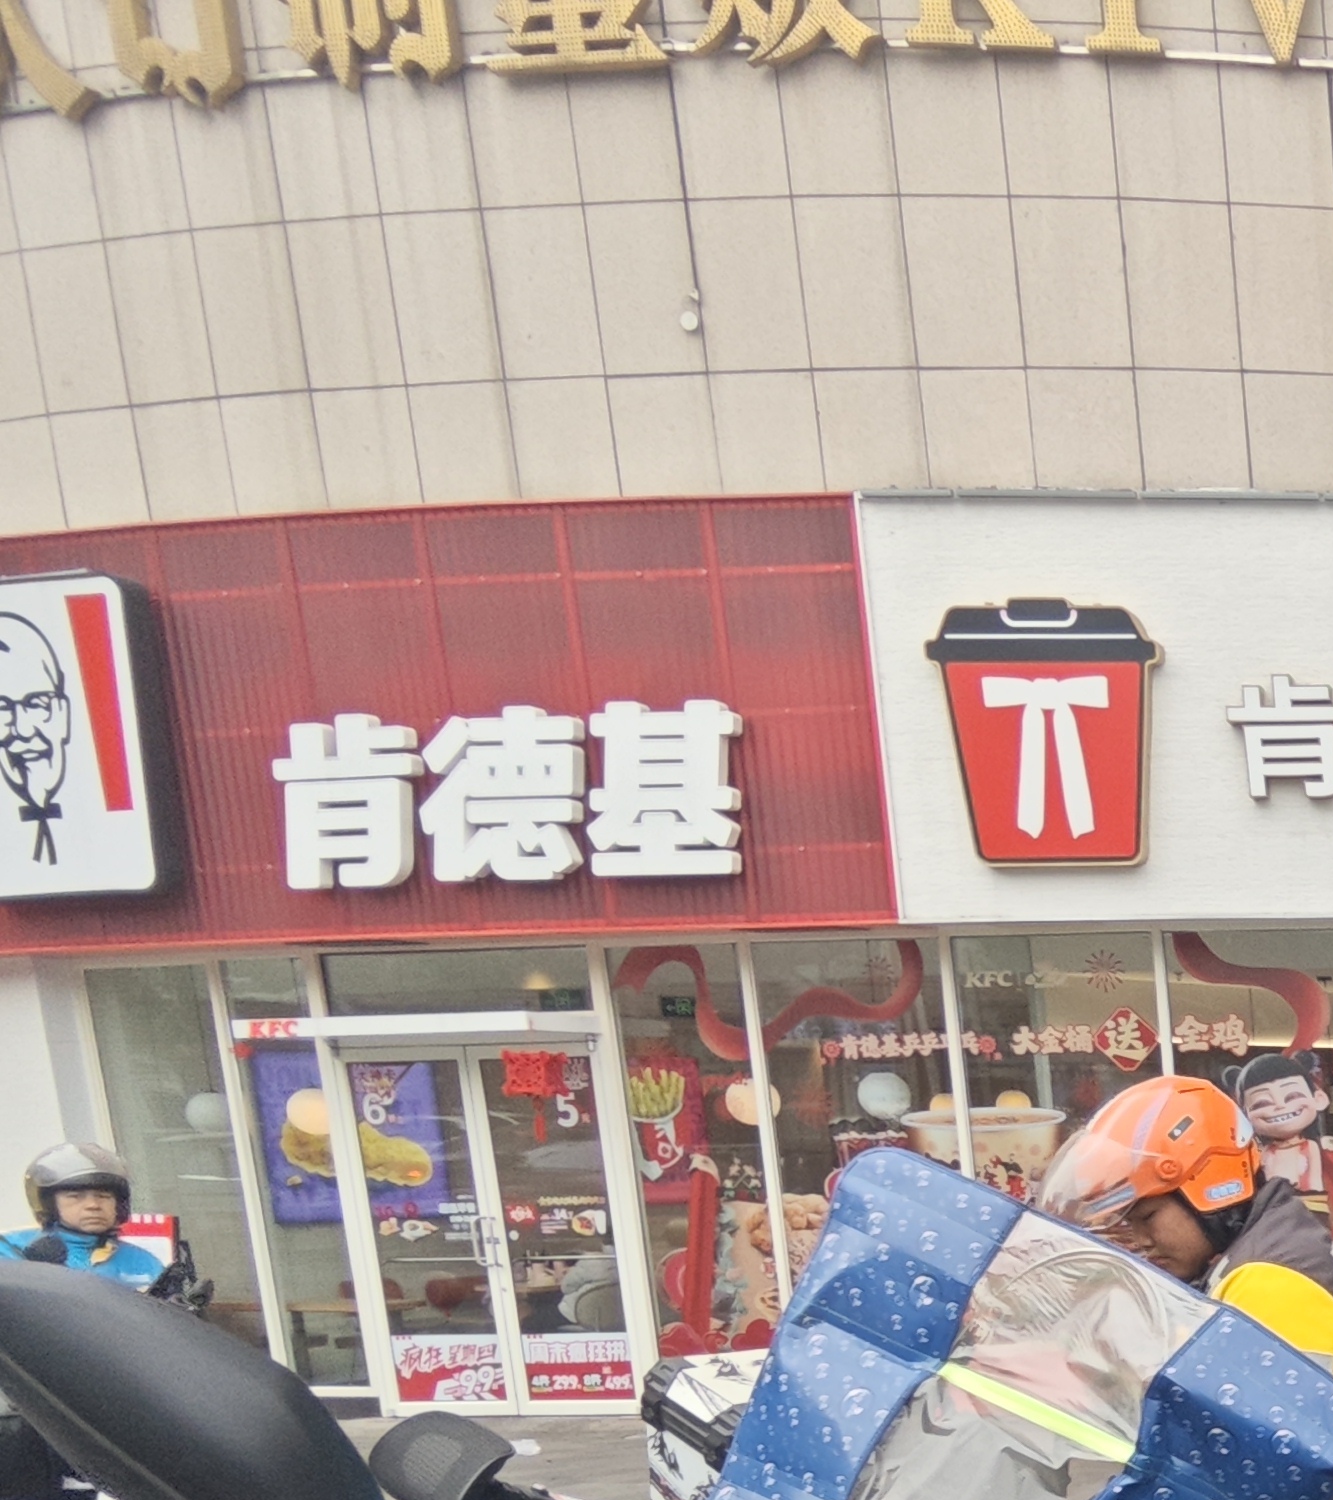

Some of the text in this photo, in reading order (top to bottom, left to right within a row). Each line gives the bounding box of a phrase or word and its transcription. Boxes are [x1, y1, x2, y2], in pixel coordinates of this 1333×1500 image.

[273, 700, 743, 889] 肯德基
[965, 970, 1013, 990] KFC
[249, 1020, 298, 1039] KFC
[842, 1031, 980, 1060] 肯德基乒乒乓
[556, 1092, 580, 1128] 5
[399, 1343, 498, 1373] 疯狂星期四
